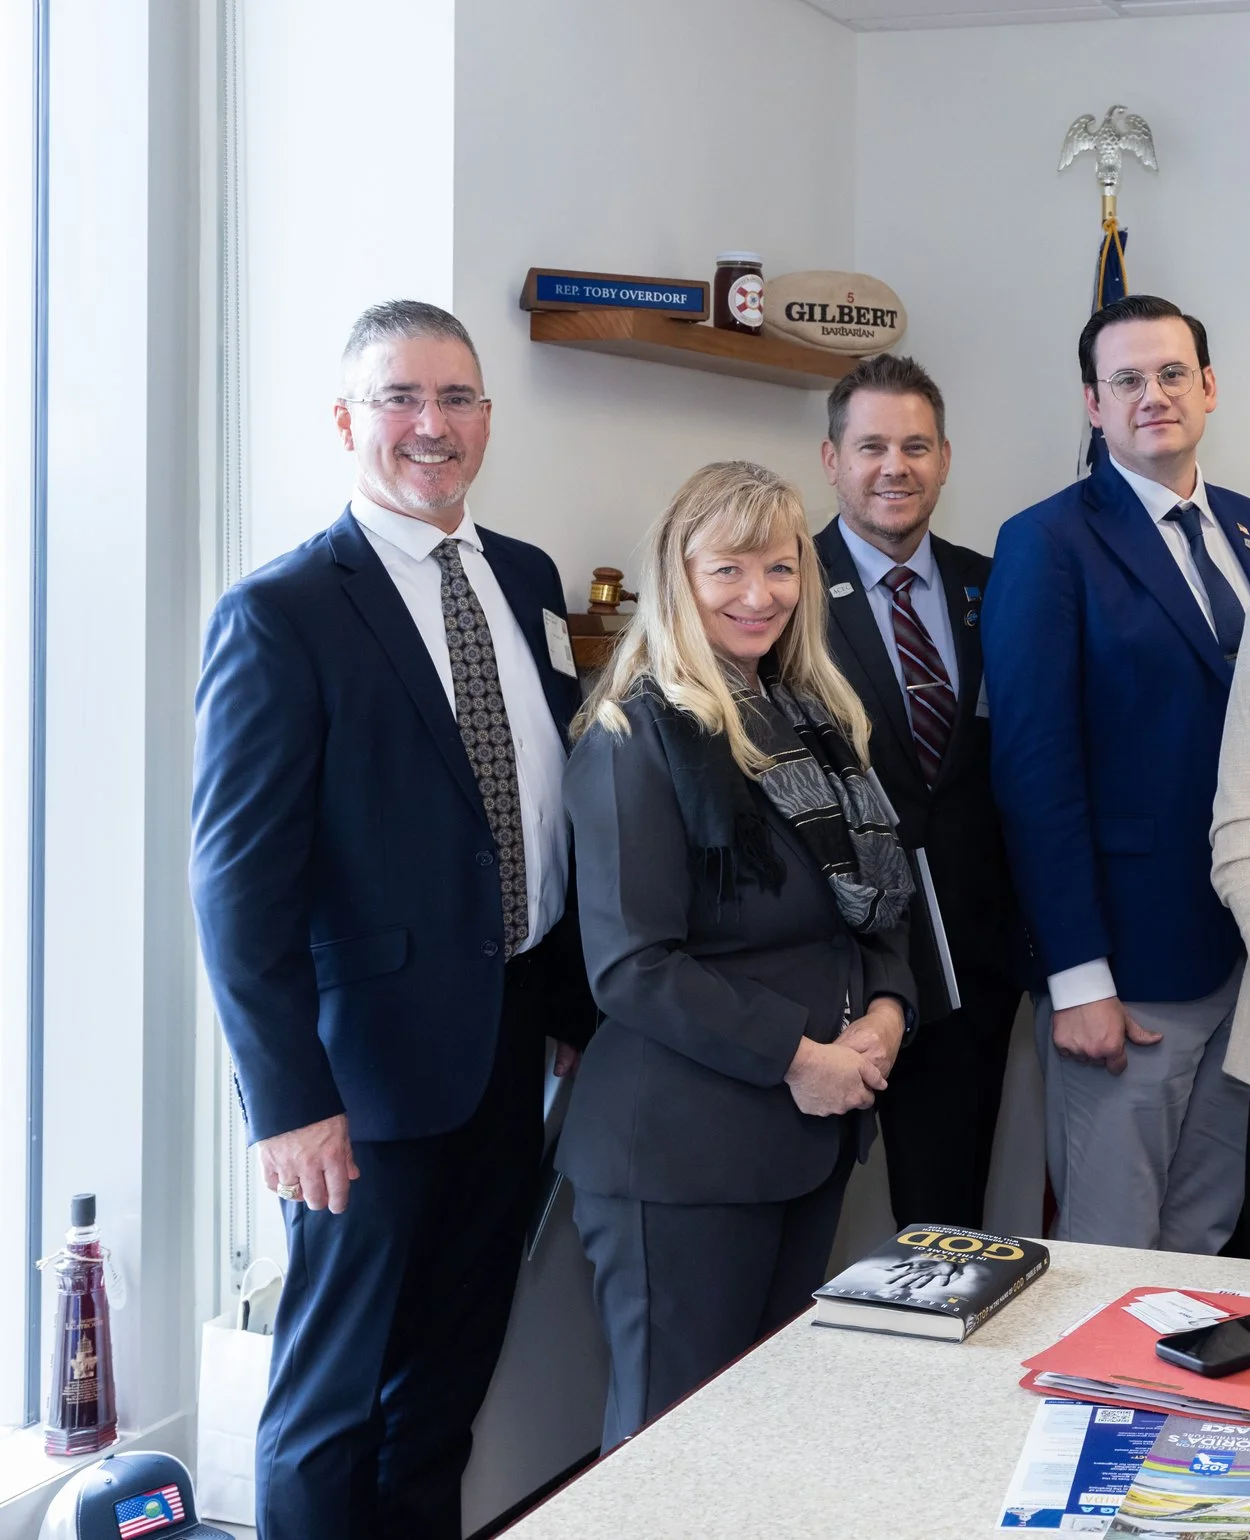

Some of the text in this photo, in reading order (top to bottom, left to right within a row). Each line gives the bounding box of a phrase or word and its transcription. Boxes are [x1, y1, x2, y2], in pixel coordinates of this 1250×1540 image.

[555, 284, 688, 304] REP. TOBY OVERDORF
[847, 292, 855, 304] 5
[785, 301, 897, 328] GILBERT
[821, 325, 875, 338] BARBARIAN
[896, 1231, 1025, 1261] GOD
[928, 1247, 955, 1257] NAME
[919, 1252, 969, 1264] STOP
[893, 1295, 960, 1312] CHARLI
[1192, 1463, 1228, 1472] 2025
[1085, 1495, 1120, 1504] RIDA
